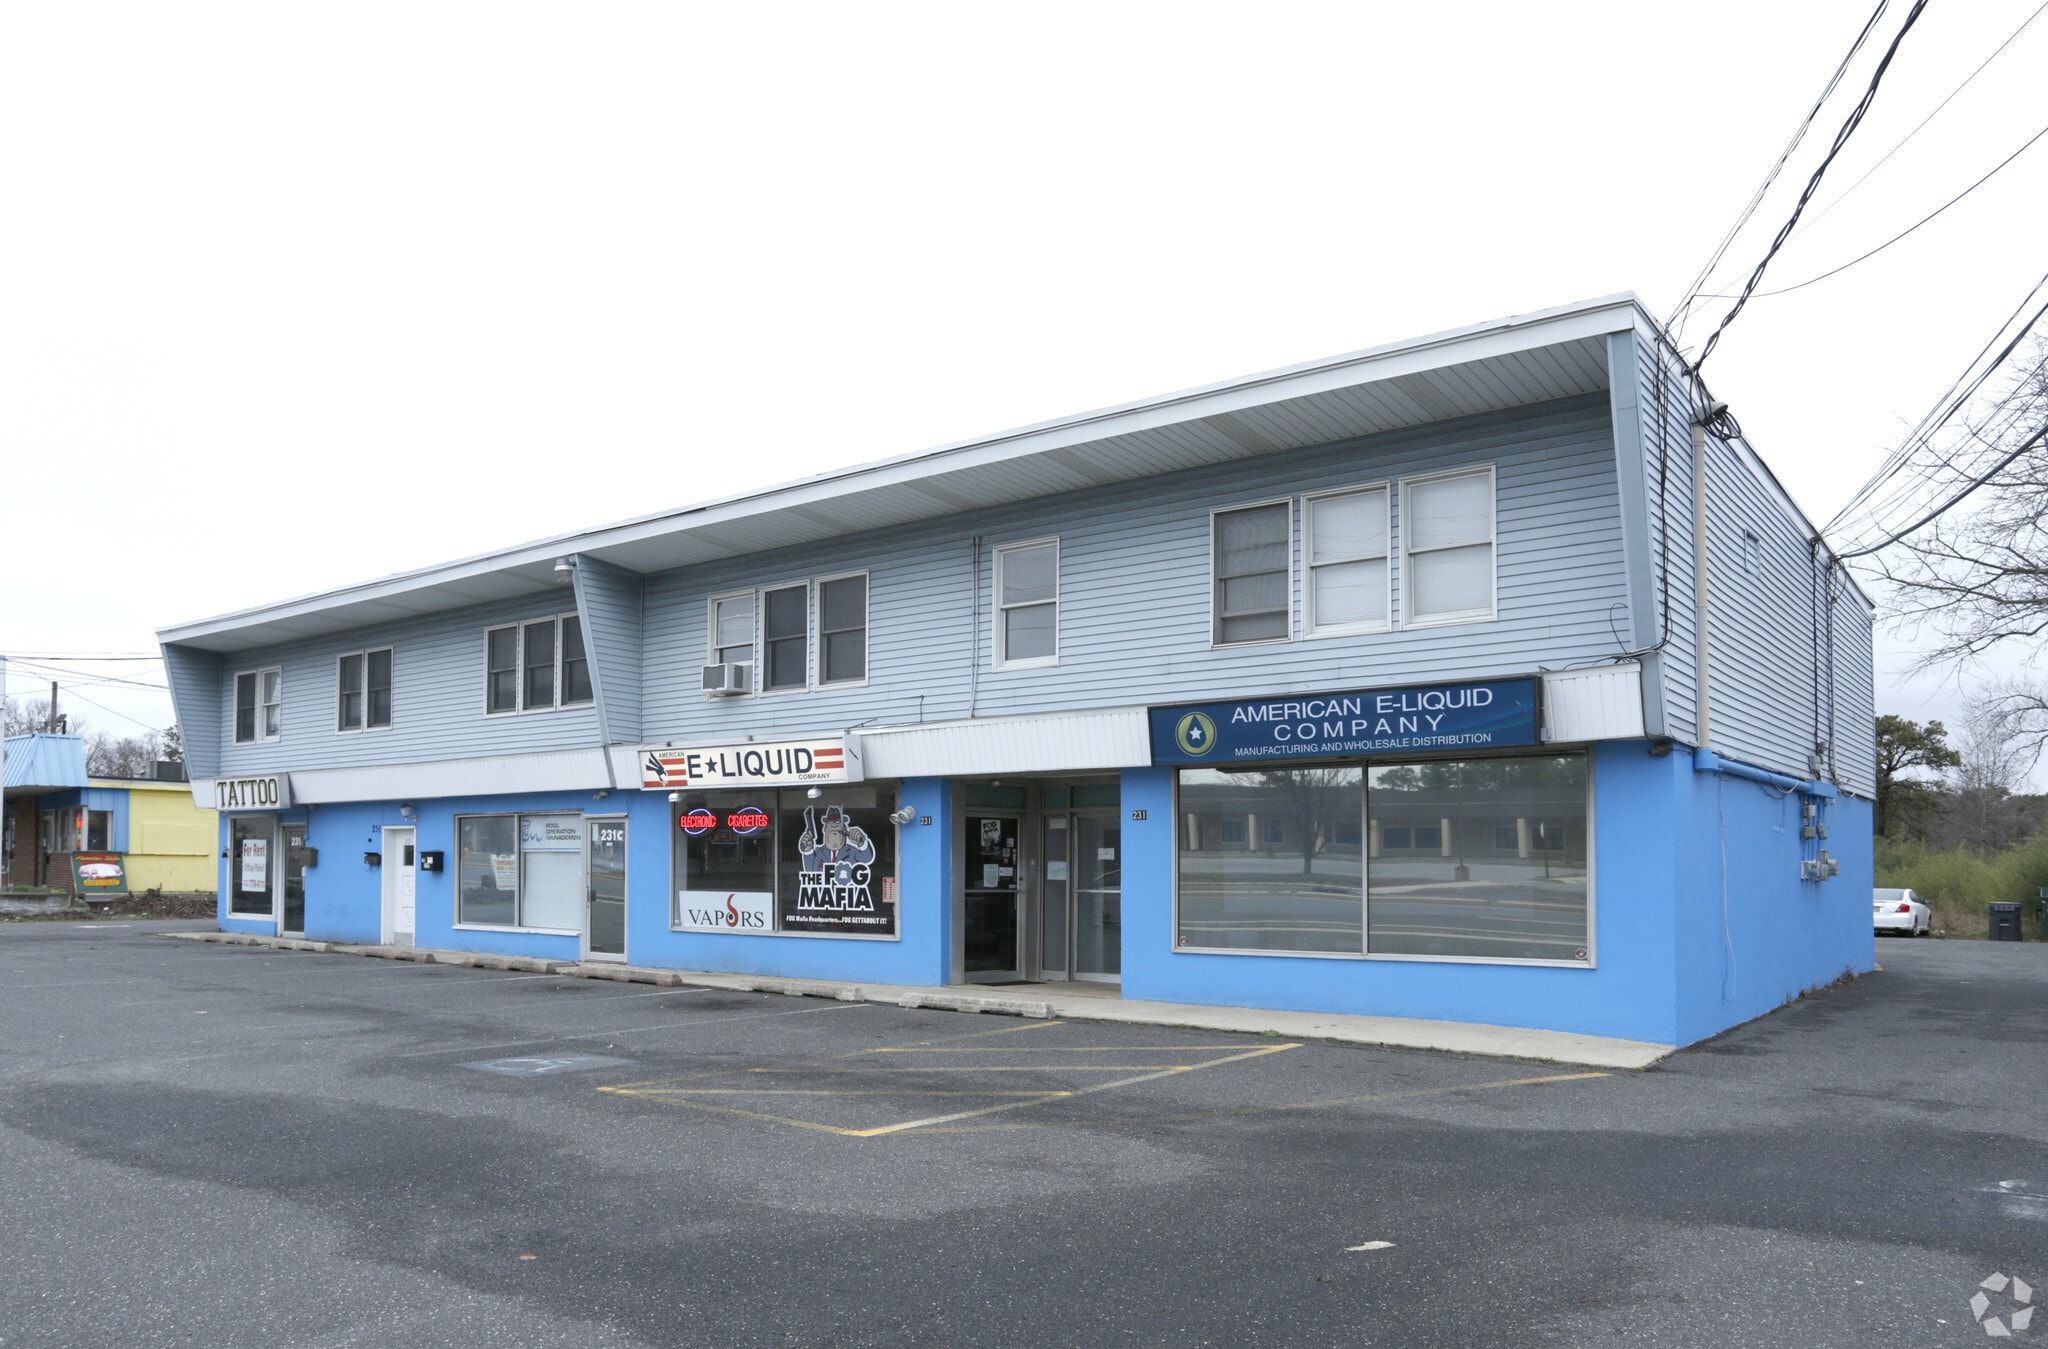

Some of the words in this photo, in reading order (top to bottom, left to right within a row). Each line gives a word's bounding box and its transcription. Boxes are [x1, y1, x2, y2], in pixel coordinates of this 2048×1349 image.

[1231, 698, 1361, 724] AMERICAN
[1376, 688, 1493, 713] E-LIQUID
[1274, 714, 1444, 741] COMPANY
[1235, 743, 1318, 757] MANUFACTURING
[1321, 742, 1343, 751] AND
[1344, 739, 1410, 750] WHOLESALE
[1412, 733, 1492, 747] DISTRIBUTION
[658, 751, 685, 759] AMERICAN
[217, 778, 279, 807] TATTOO
[680, 815, 717, 828] ELECTRONIC
[727, 814, 768, 827] CIGARETTES
[920, 816, 931, 825] 231
[1133, 811, 1146, 820] 231
[601, 829, 624, 841] 231C
[243, 843, 252, 857] For
[253, 843, 265, 857] Rent
[800, 873, 822, 886] THE
[824, 862, 869, 887] FOG
[799, 887, 873, 910] MAFIA
[688, 893, 764, 928] VAPORS
